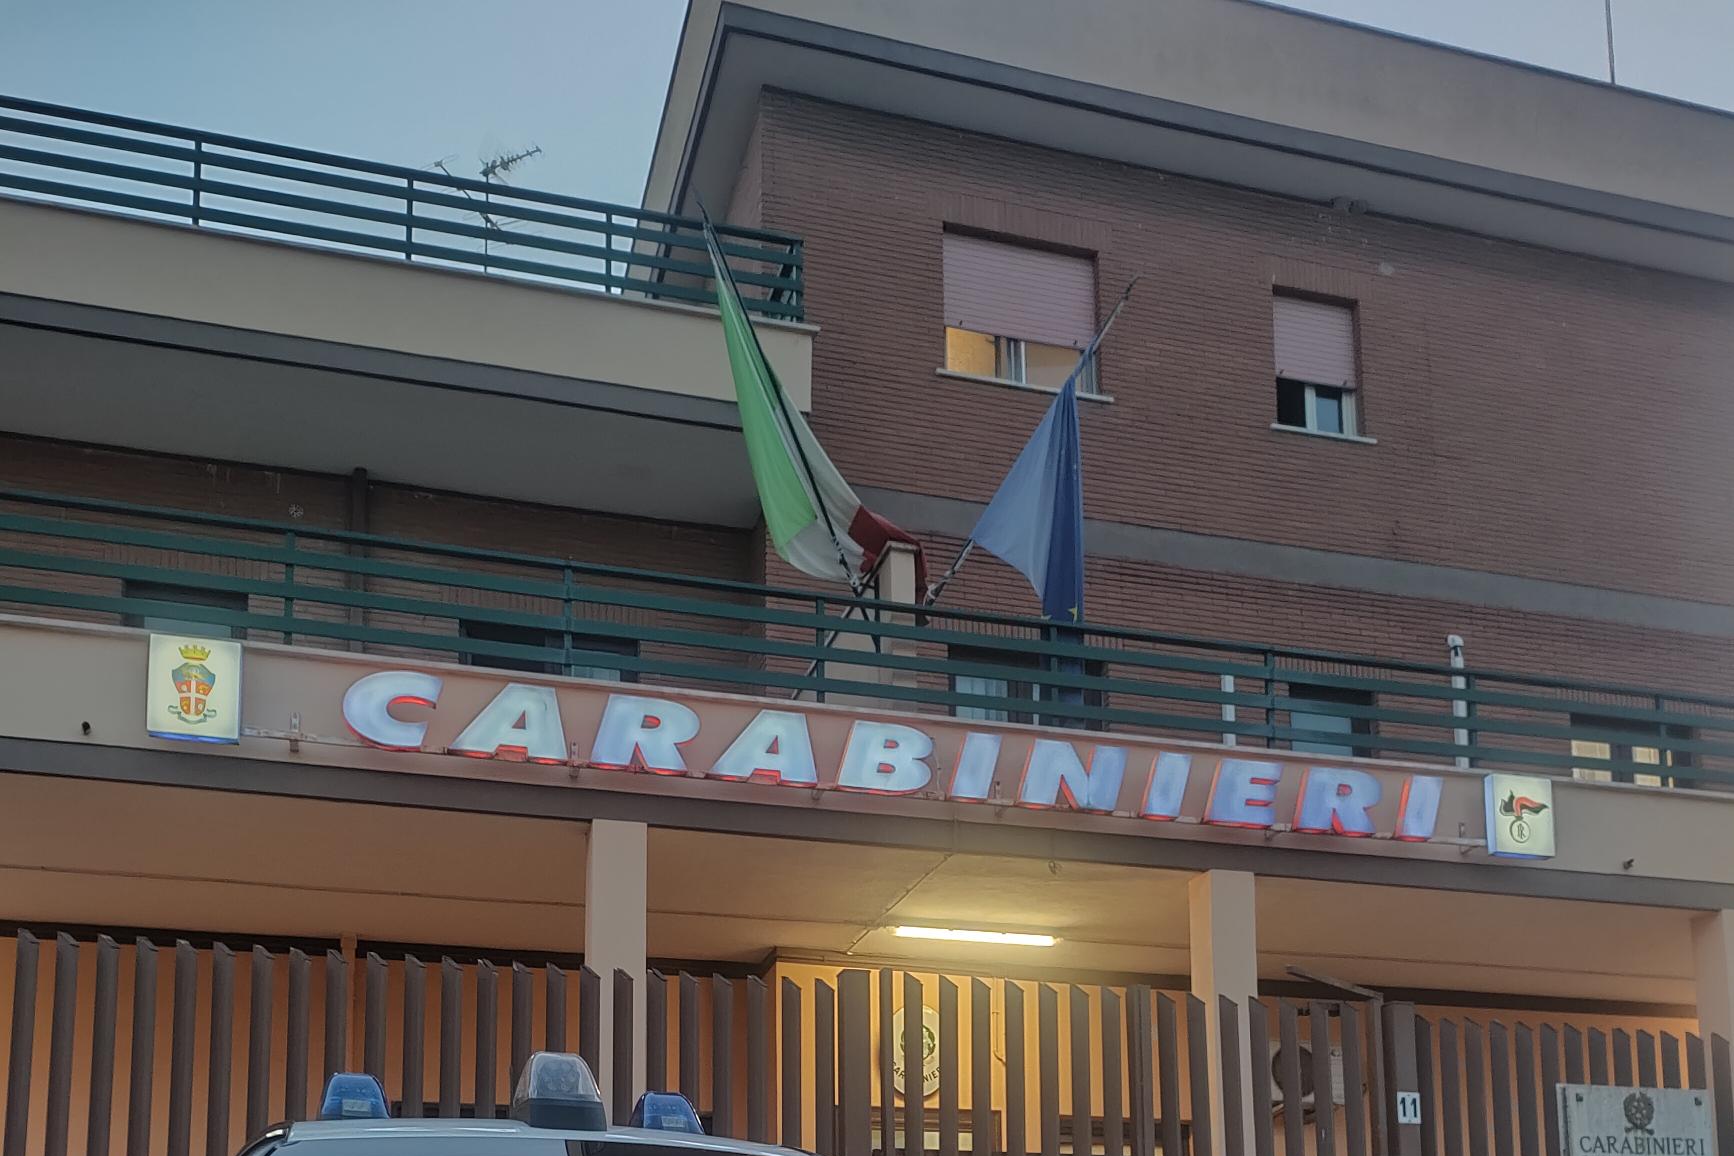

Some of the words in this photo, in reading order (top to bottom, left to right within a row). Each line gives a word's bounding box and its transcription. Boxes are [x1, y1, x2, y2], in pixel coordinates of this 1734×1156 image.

[343, 671, 1443, 842] CARABINIERI
[1400, 1097, 1417, 1118] 11
[1579, 1136, 1705, 1156] CARABINIERI
